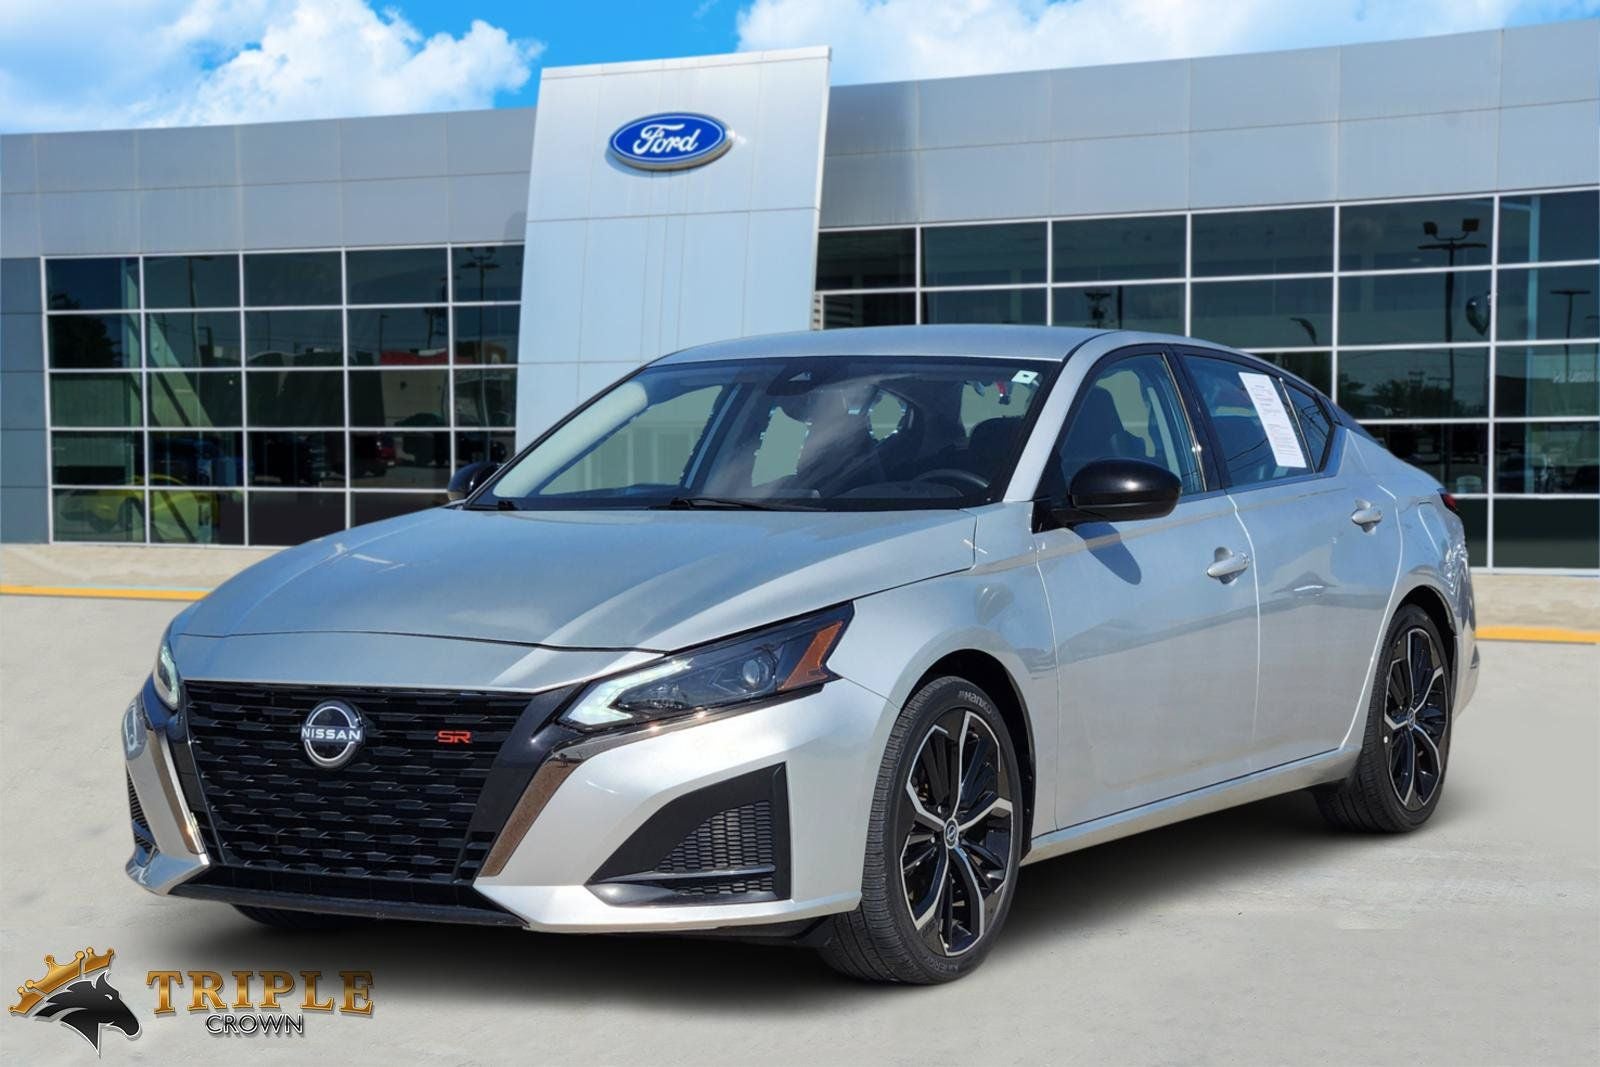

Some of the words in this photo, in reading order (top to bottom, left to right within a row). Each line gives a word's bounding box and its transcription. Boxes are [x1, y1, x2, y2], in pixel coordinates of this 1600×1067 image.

[632, 123, 702, 155] Ford
[301, 726, 362, 741] NISSAN
[436, 730, 472, 744] SR
